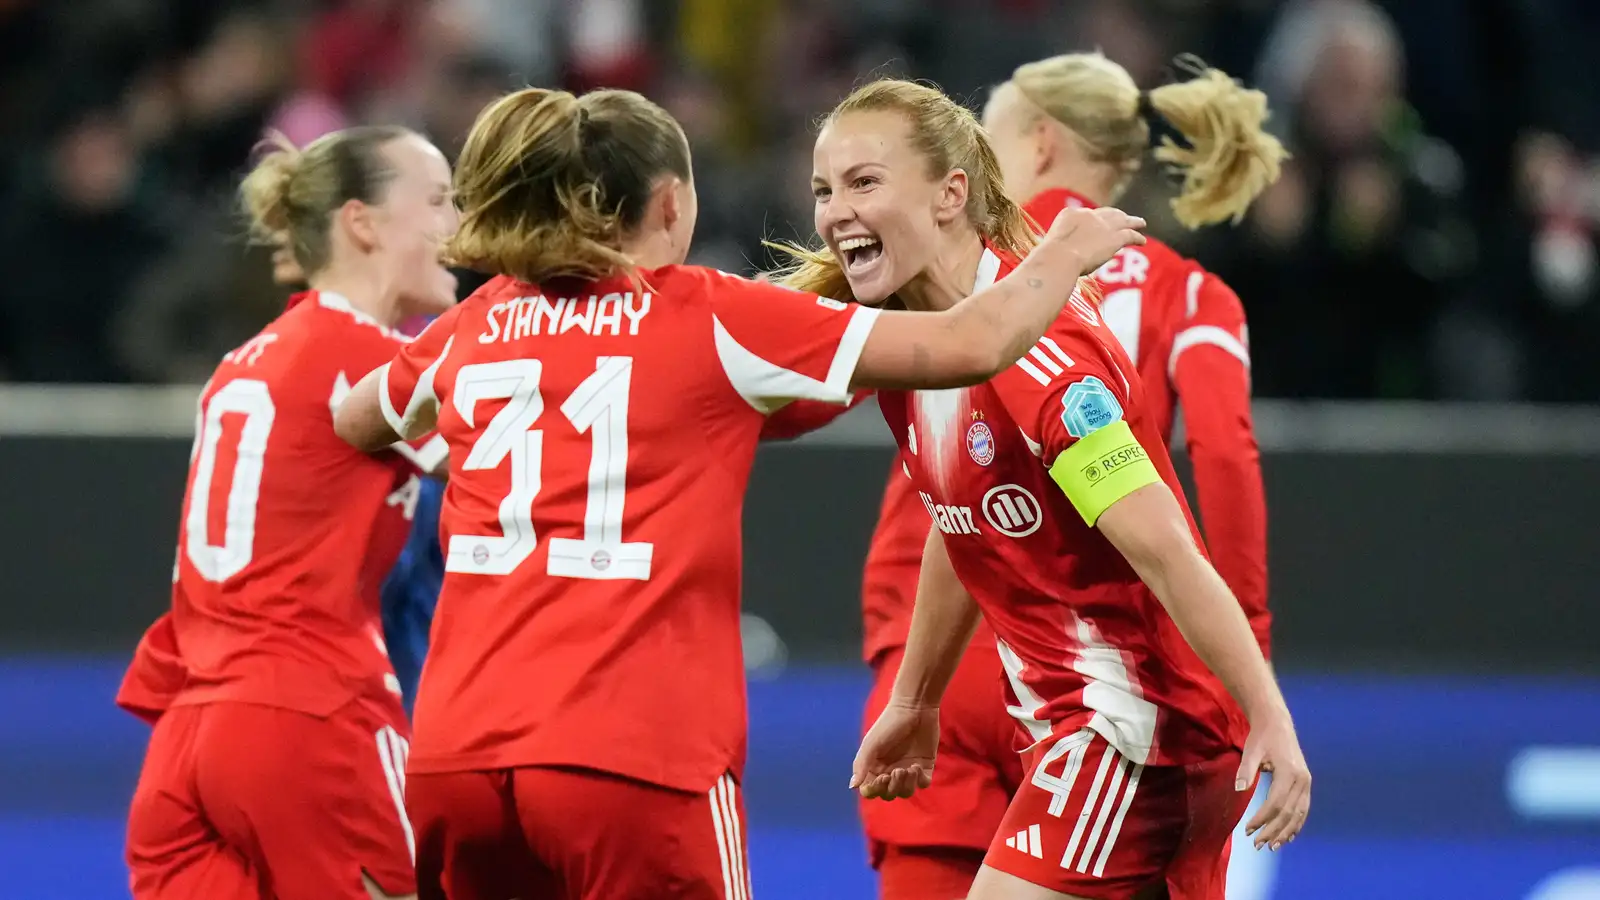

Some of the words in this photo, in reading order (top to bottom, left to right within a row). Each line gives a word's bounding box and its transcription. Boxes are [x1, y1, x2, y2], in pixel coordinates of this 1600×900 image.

[478, 292, 652, 344] STANWAY
[173, 378, 276, 583] 0
[445, 355, 654, 581] 31
[918, 490, 981, 535] llianz
[1031, 727, 1097, 818] 4
